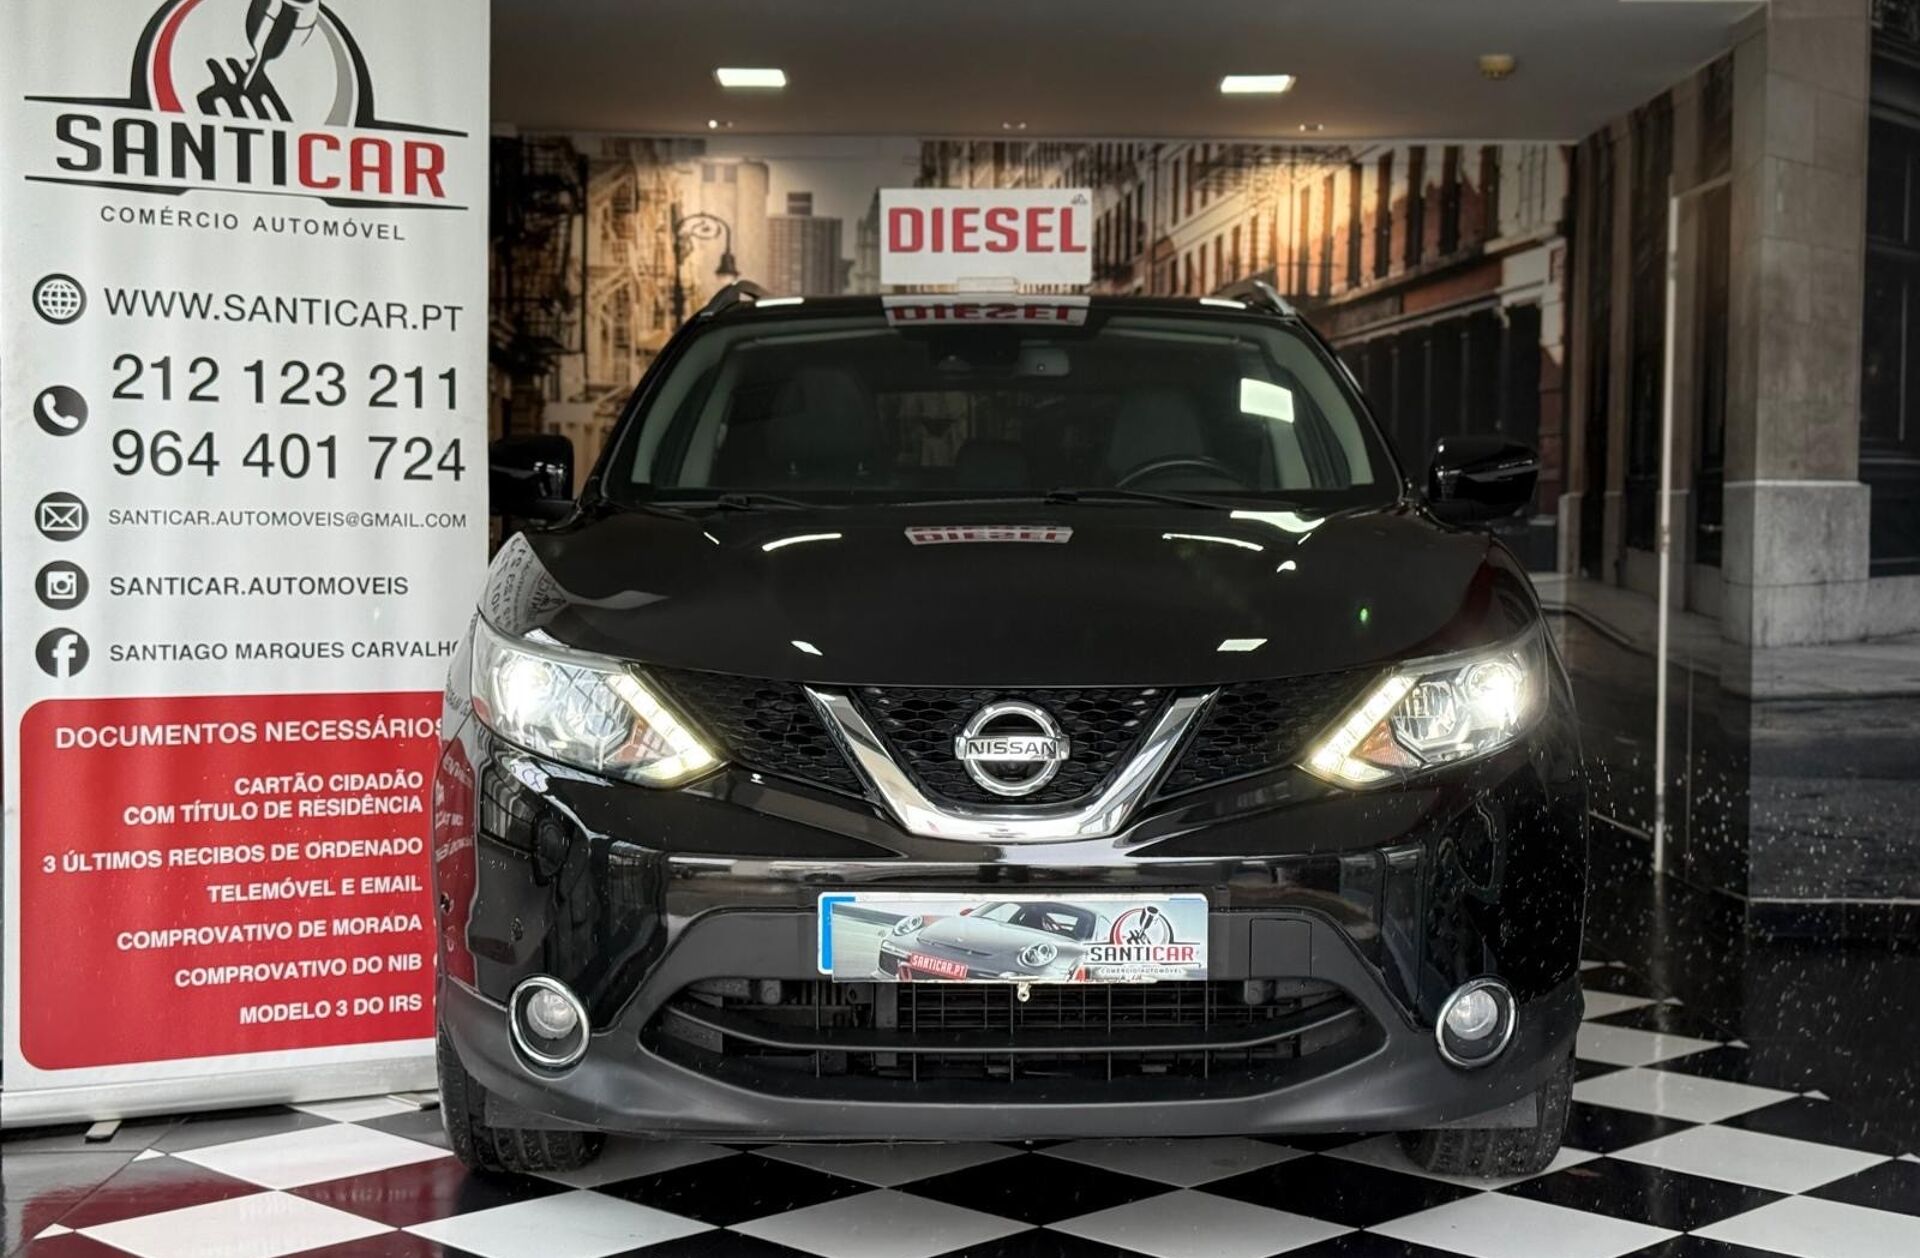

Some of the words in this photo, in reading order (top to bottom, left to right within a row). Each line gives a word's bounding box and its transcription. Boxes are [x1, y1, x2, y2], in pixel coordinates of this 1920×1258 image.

[56, 114, 445, 198] SANTICAR
[101, 206, 239, 230] COMÉRCIO
[253, 216, 405, 240] AUTOMÓVEL
[888, 207, 1087, 253] DIESEL
[104, 288, 463, 332] WWW.SANTICAR.PT
[112, 353, 220, 402] 212
[243, 360, 347, 407] 123
[368, 364, 456, 410] 211
[112, 429, 220, 477] 964
[242, 432, 337, 479] 401
[368, 435, 466, 481] 724
[109, 509, 466, 528] SANTICAR.AUTOMOVEIS@GMAIL.COM
[110, 576, 409, 596] SANTICAR.AUTOMOVEIS
[110, 644, 228, 661] SANTIAGO
[235, 642, 345, 660] MARQUES
[56, 722, 257, 749] DOCUMENTOS
[968, 741, 1057, 755] NISSAN
[234, 773, 322, 795] CARTÃO
[329, 769, 423, 791] CIDADÃO
[123, 806, 175, 825] COM
[181, 800, 257, 822] TÍTULO
[264, 801, 292, 819] DE
[299, 794, 423, 818] RESIDÊNCIA
[43, 855, 55, 873] 3
[63, 849, 162, 872] ÚLTIMOS
[169, 845, 264, 866] RECIBOS
[271, 843, 298, 861] DE
[305, 837, 423, 860] ORDENADO
[207, 879, 336, 903] TELEMÓVEL
[341, 878, 354, 895] E
[361, 875, 423, 893] EMAIL
[117, 922, 292, 950] COMPROVATIVO
[298, 919, 326, 937] DE
[333, 914, 422, 935] MORADA
[911, 954, 965, 978] SANTICAR.PT
[1090, 946, 1194, 961] SANTICAR
[175, 960, 347, 987] COMPROVATIVO
[353, 957, 382, 975] DO
[389, 954, 422, 972] NIB
[240, 1000, 331, 1024] MODELO
[336, 1000, 348, 1016] 3
[354, 998, 383, 1015] DO
[390, 994, 422, 1012] IRS
